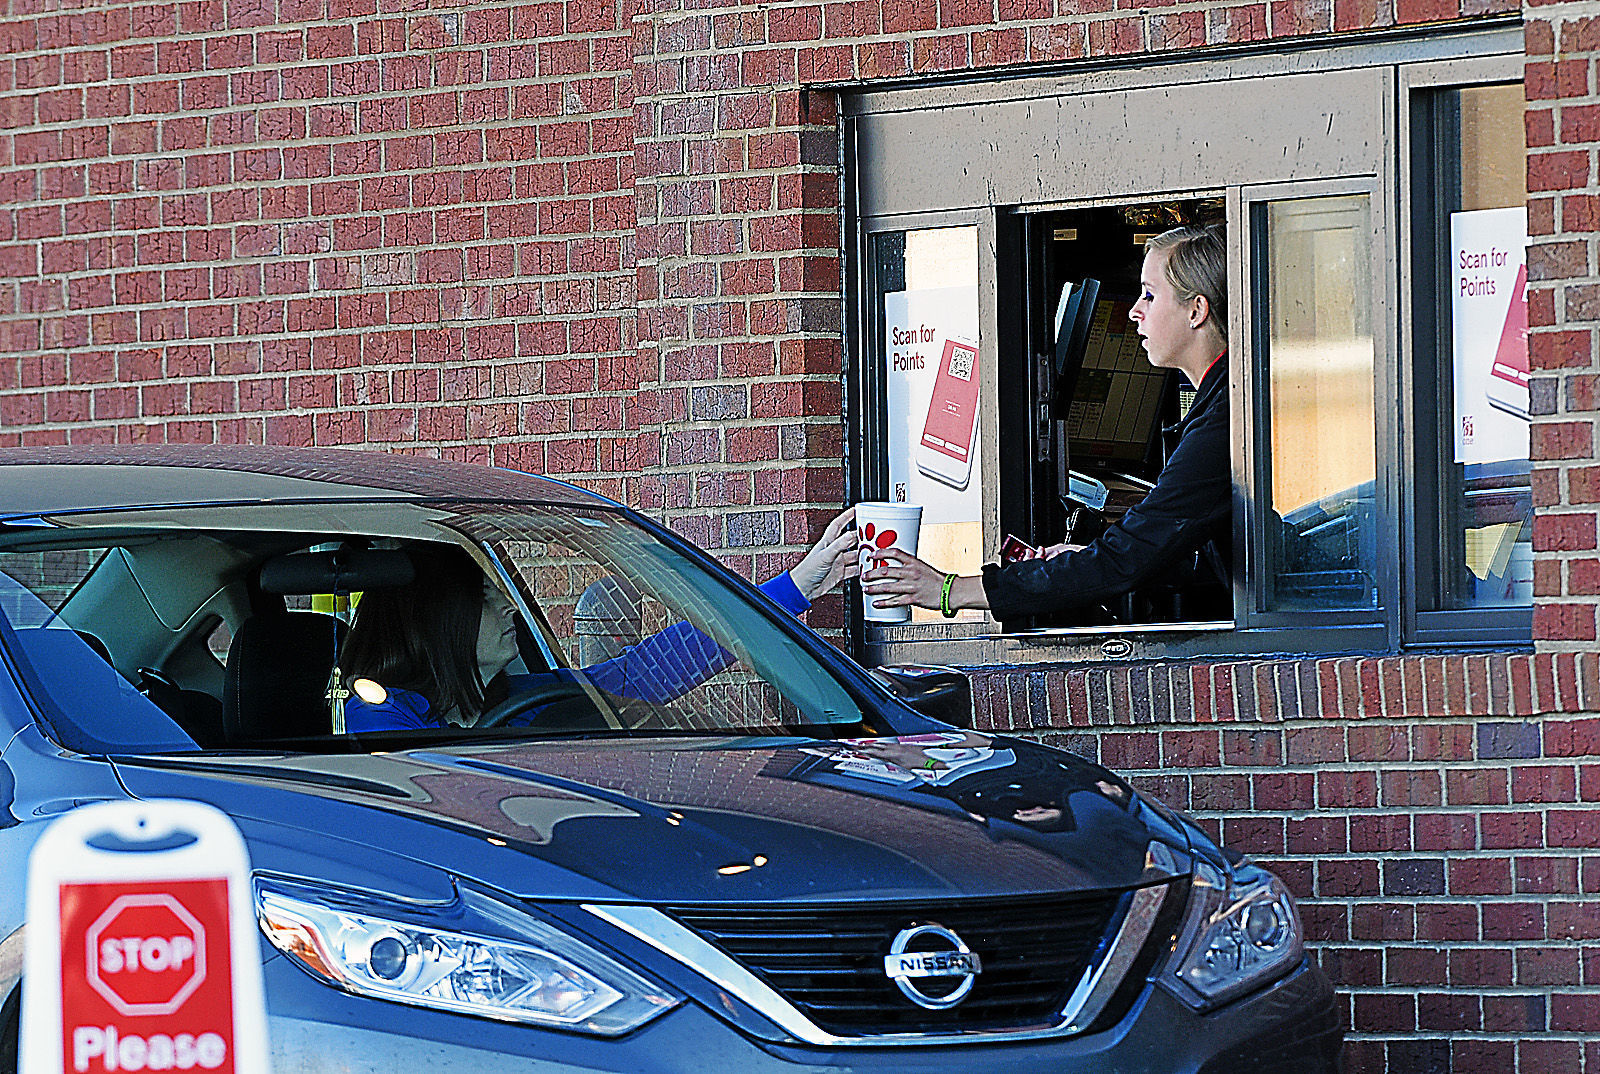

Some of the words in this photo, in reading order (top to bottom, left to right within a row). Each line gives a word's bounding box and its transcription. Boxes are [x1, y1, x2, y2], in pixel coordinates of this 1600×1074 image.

[1459, 249, 1488, 270] Scan
[1491, 247, 1508, 267] for
[1460, 275, 1496, 297] Points
[892, 326, 918, 346] Scan
[919, 323, 936, 343] for
[893, 350, 925, 372] Points
[100, 936, 194, 973] STOP
[900, 956, 974, 971] NISSAN
[73, 1024, 226, 1073] Please
